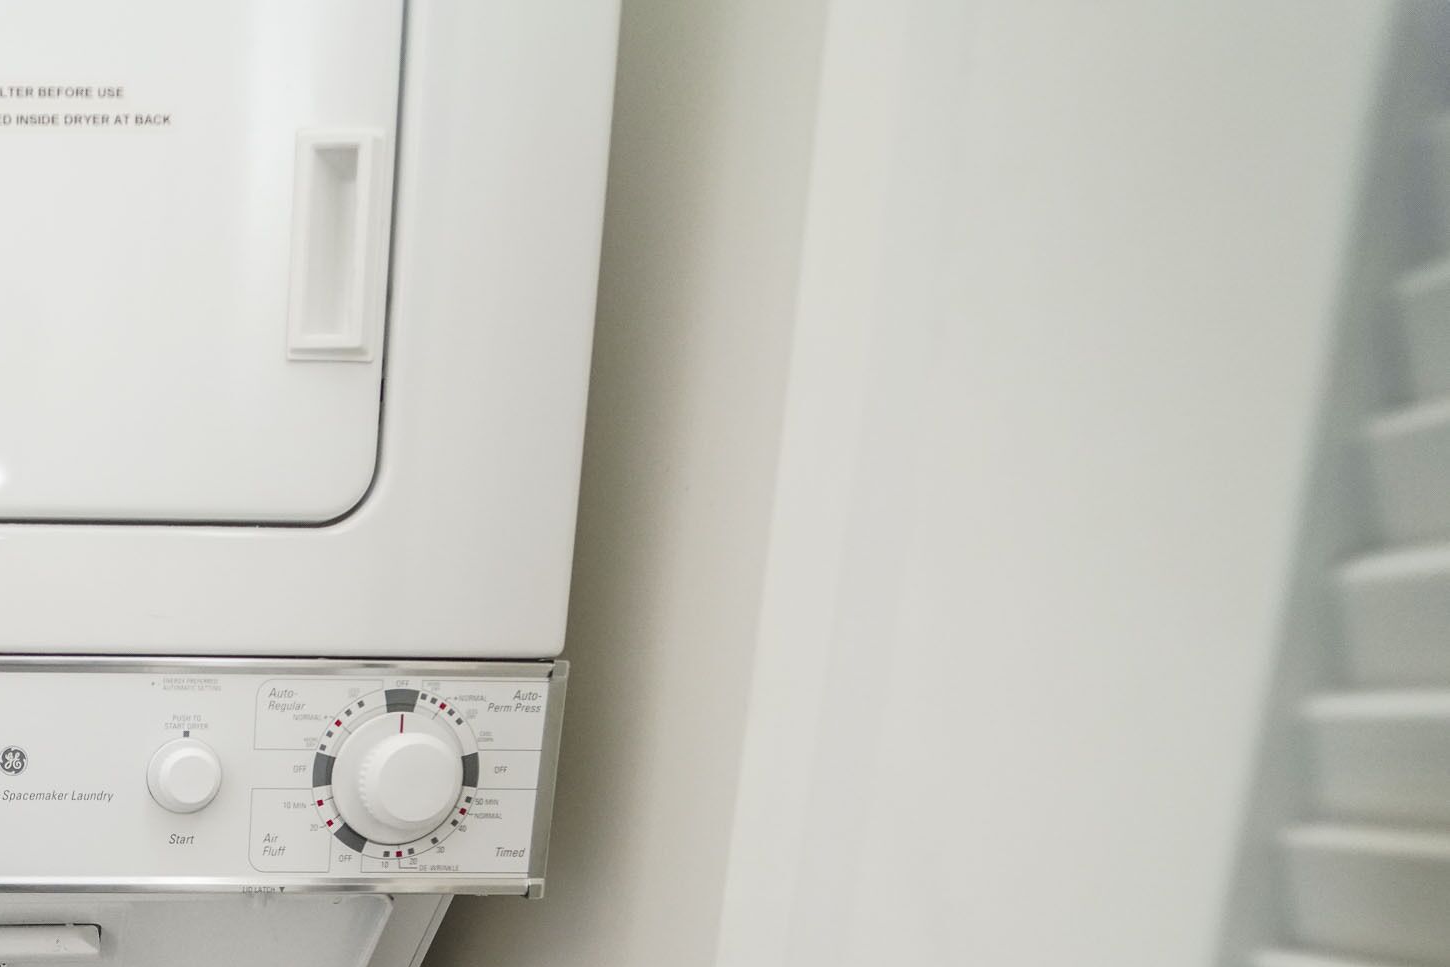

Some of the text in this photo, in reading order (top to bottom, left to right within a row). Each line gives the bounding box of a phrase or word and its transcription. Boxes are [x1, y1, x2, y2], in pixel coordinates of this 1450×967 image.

[38, 86, 93, 98] BEFORE
[97, 86, 124, 98] USE
[16, 114, 59, 126] INSIDE
[64, 114, 110, 126] DRYER
[114, 114, 129, 126] AT
[134, 114, 171, 126] BACK
[269, 688, 298, 699] Auto-
[513, 690, 542, 701] Auto-
[268, 701, 305, 712] Regular
[487, 703, 541, 713] Perm Press
[2, 790, 114, 803] Spacemaker Laundry
[169, 833, 195, 845] Start
[263, 833, 278, 843] Air
[263, 846, 286, 857] Fluff
[495, 847, 525, 858] Timed
[339, 854, 352, 863] OFF
[381, 861, 389, 869] 10
